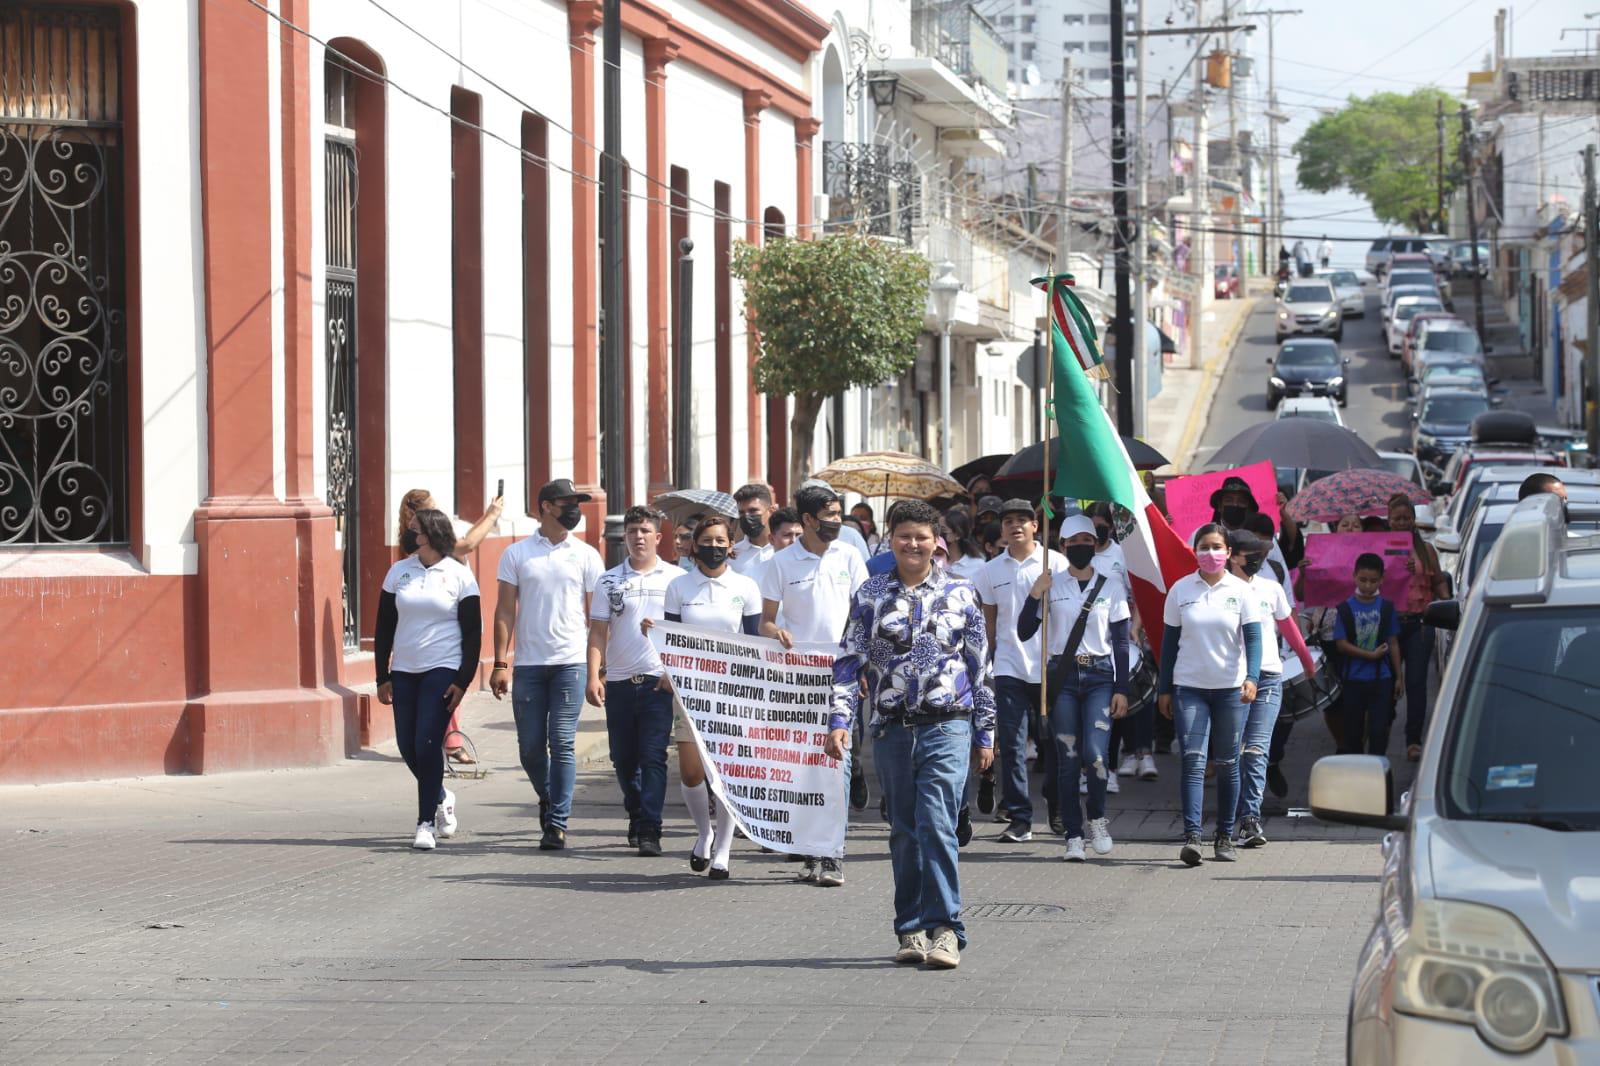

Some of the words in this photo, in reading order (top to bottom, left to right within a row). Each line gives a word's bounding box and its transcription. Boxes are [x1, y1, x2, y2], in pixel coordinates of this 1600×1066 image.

[666, 632, 715, 652] PRESIDENTE
[716, 641, 761, 660] MUNICIPAL
[766, 648, 783, 664] LUIS
[785, 652, 834, 668] GUILLERMO
[660, 653, 693, 670] BENITEZ
[695, 658, 727, 674] TORRES
[731, 663, 764, 680] CUMPLA
[767, 668, 783, 683] CON
[786, 672, 794, 685] EL
[796, 672, 834, 687] MANDAT
[672, 675, 682, 689] EN
[684, 677, 692, 690] EL
[694, 678, 716, 694] TEMA
[718, 682, 765, 702] EDUCATIVO,
[769, 689, 805, 704] CUMPLA
[807, 693, 826, 705] CON
[716, 702, 726, 715] DE
[728, 704, 737, 717] LA
[739, 705, 753, 719] LEY
[755, 708, 765, 721] DE
[768, 709, 818, 725] EDUCACIÓN
[696, 719, 706, 732] DE
[708, 720, 743, 738] SINALOA
[748, 726, 790, 742] ARTÍCULO
[793, 730, 807, 744] 134
[813, 733, 826, 746] 137
[719, 742, 734, 756] 142
[738, 744, 752, 758] DEL
[754, 746, 800, 765] PROGRAMA
[802, 752, 827, 766] ANUAL
[828, 756, 838, 769] DE
[723, 761, 766, 780] PÚBLICAS
[770, 768, 793, 783] 2022.
[728, 783, 748, 799] PARA
[750, 786, 766, 800] LOS
[768, 788, 824, 806] ESTUDIANTES
[752, 826, 760, 838] EL
[760, 828, 794, 845] RECREO.
